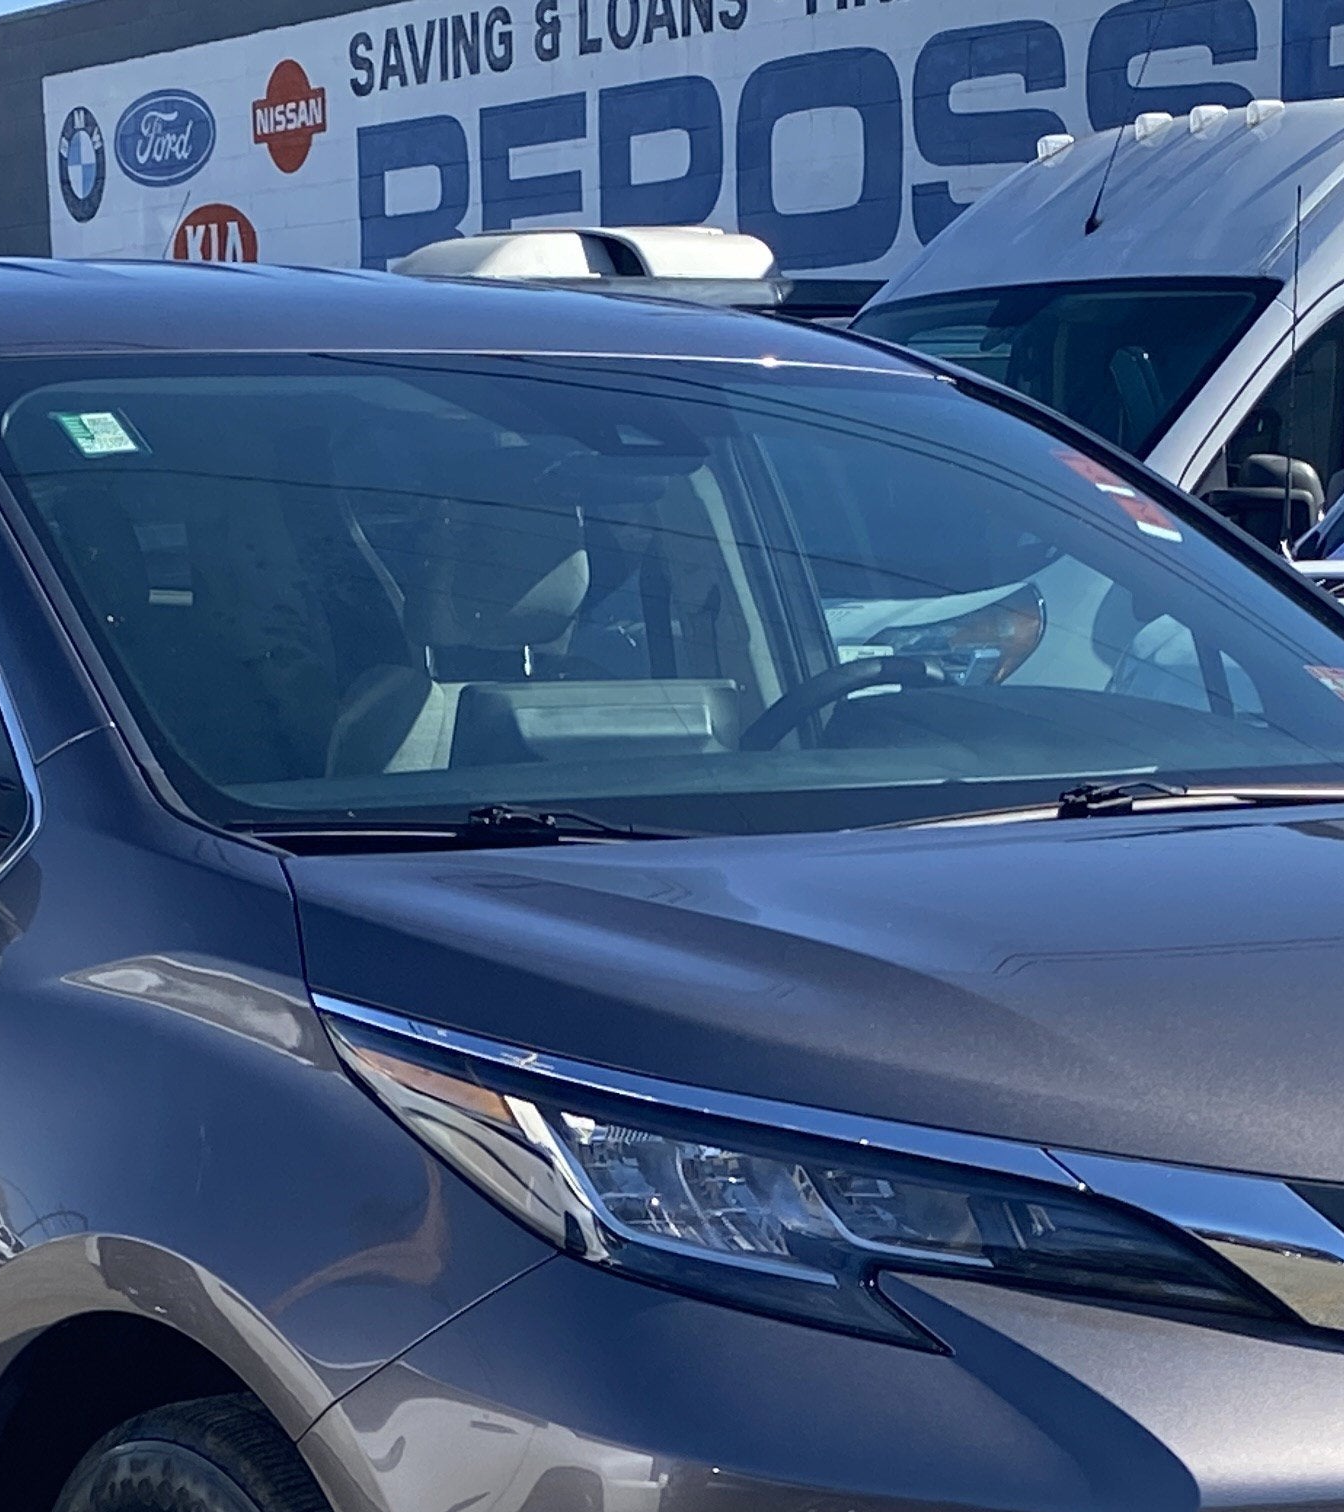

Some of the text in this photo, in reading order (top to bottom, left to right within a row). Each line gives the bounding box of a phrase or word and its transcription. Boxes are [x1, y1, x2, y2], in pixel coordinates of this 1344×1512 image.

[349, 5, 513, 97] SAVING
[535, 0, 561, 62] &
[136, 110, 193, 165] Ford
[255, 97, 322, 136] NISSAN
[185, 220, 243, 263] KIA
